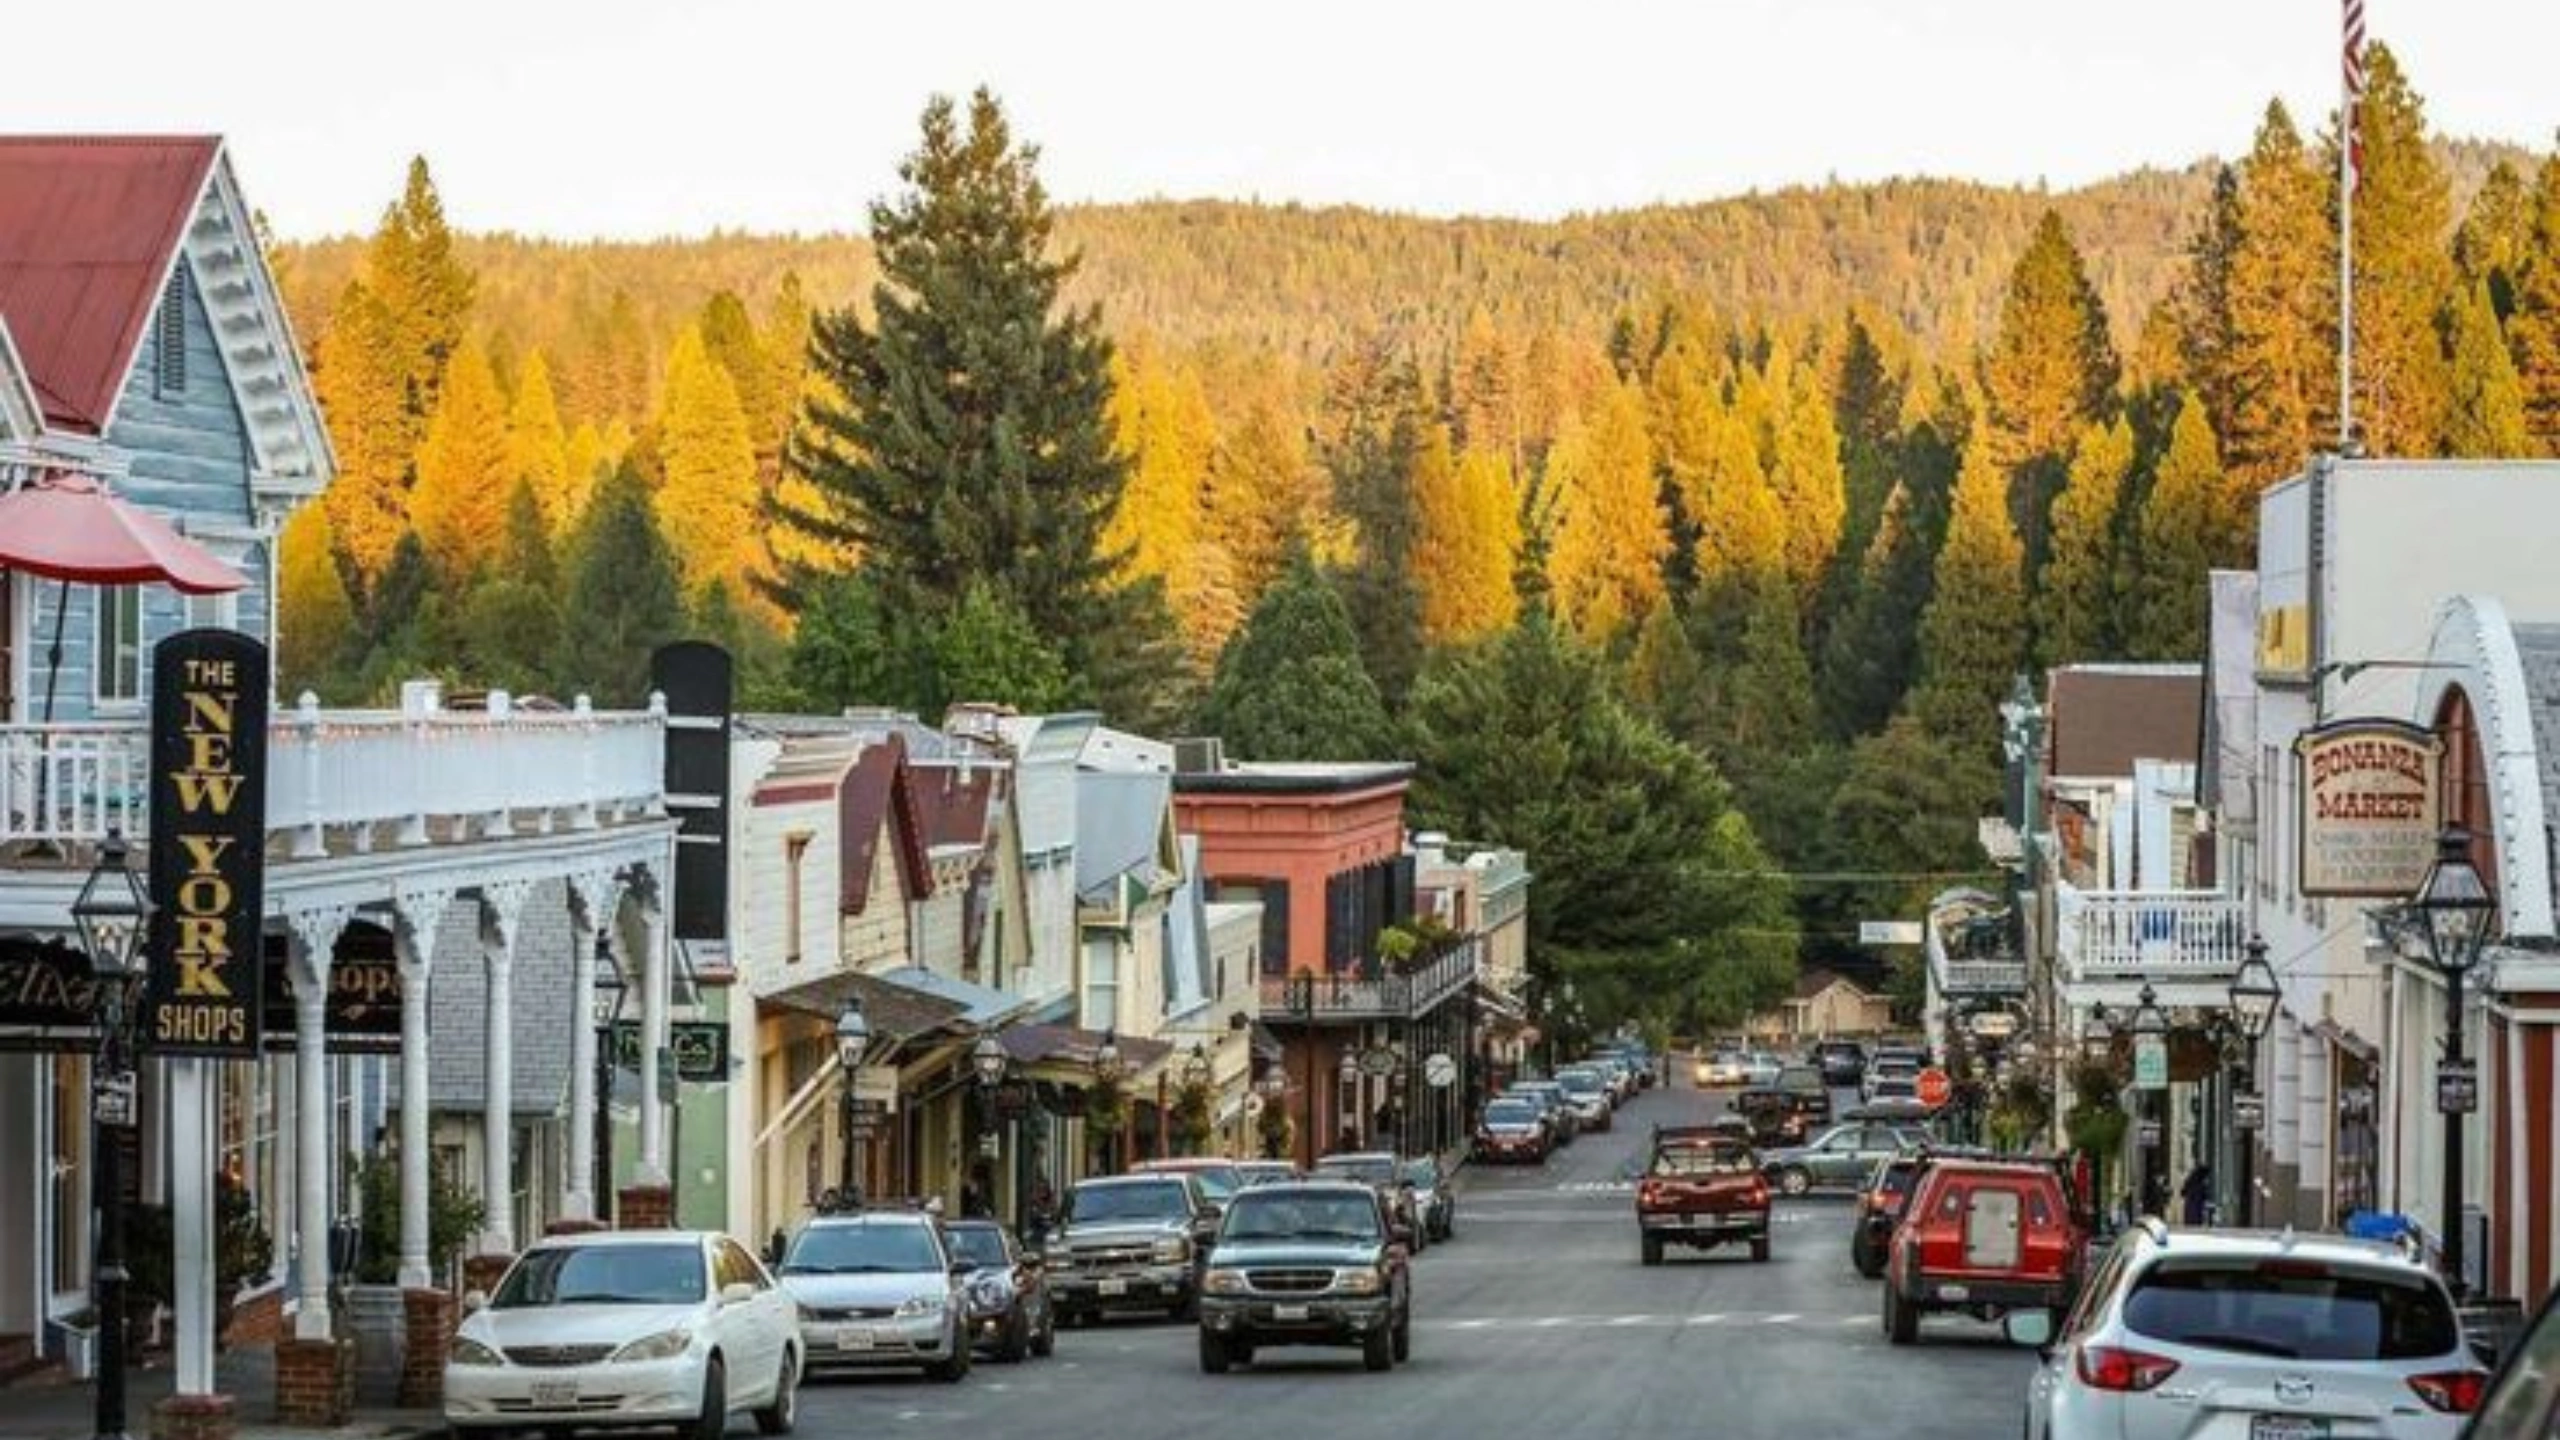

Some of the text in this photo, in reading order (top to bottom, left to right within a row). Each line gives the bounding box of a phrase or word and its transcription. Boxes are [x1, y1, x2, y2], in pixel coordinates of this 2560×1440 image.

[184, 660, 235, 686] THE
[2312, 742, 2427, 789] BONANZA
[2316, 792, 2425, 820] MARKET
[169, 691, 245, 996] NEW YORK
[156, 1004, 245, 1042] SHOPS
